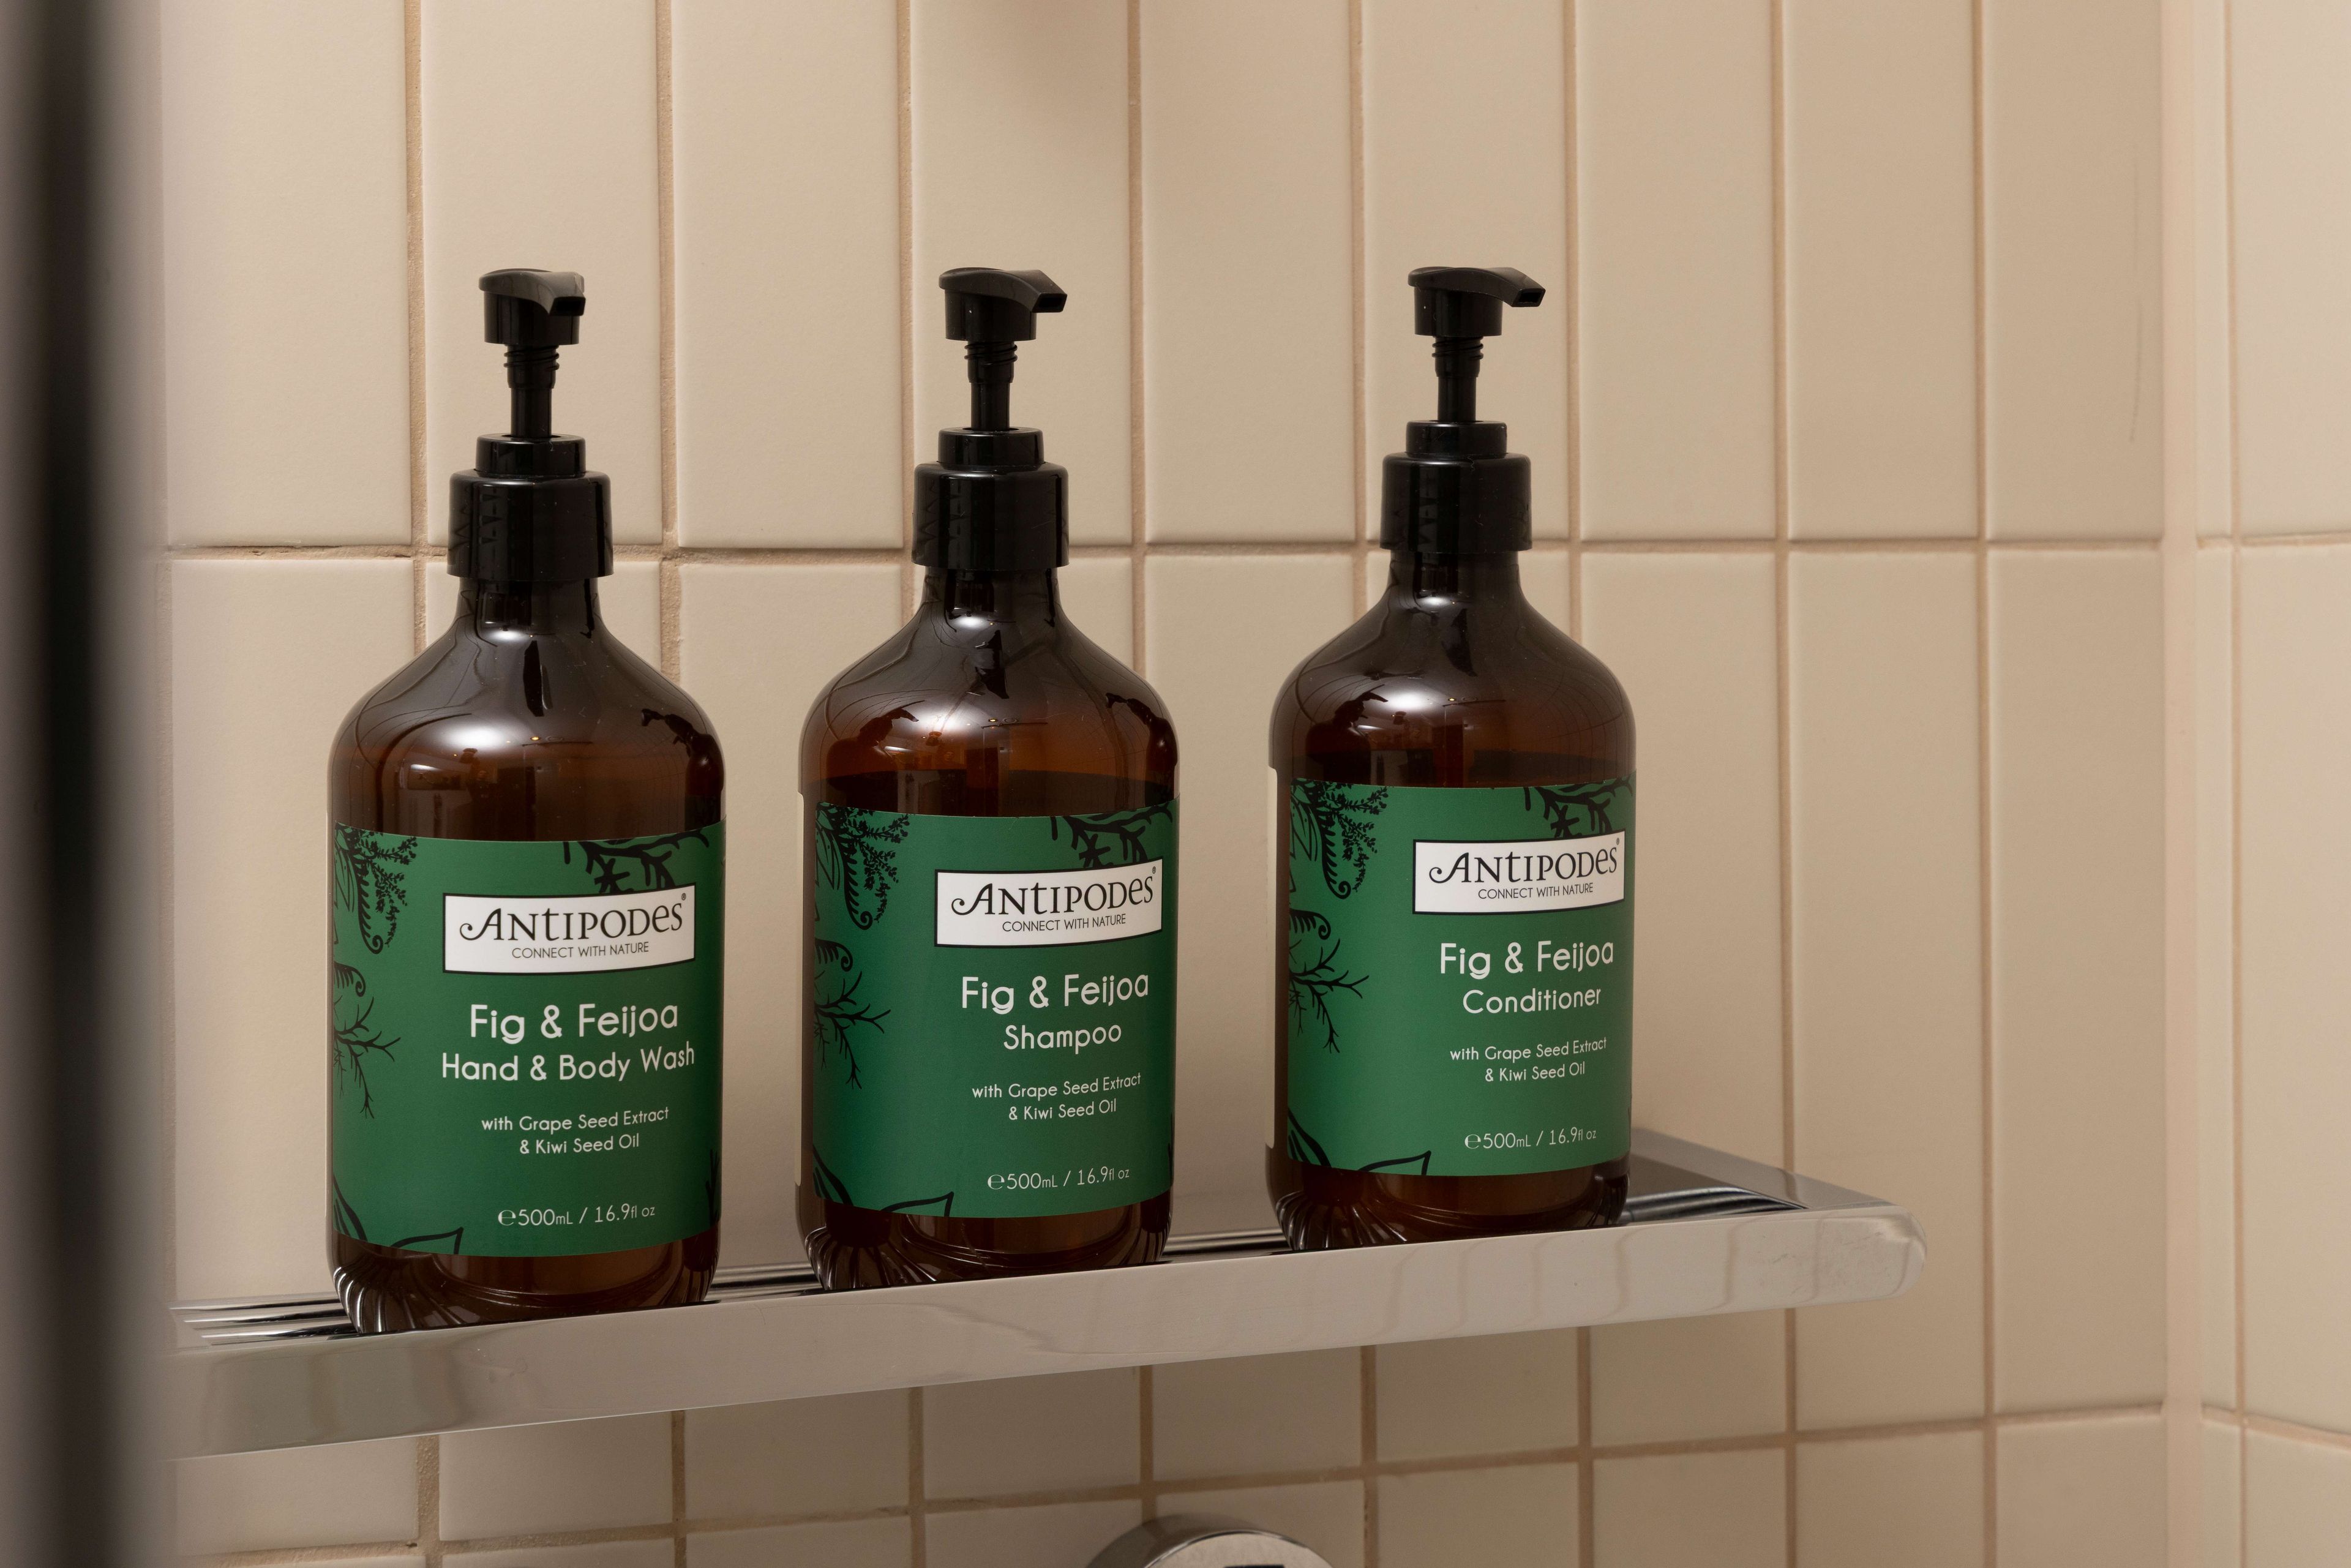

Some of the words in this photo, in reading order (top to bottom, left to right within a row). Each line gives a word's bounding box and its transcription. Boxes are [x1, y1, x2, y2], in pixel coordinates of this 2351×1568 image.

[1478, 887, 1534, 899] CONNECT
[1536, 886, 1560, 898] WITH
[1562, 882, 1594, 896] NATURE
[1002, 920, 1061, 932] CONNECT
[1063, 918, 1089, 930] WITH
[1092, 913, 1126, 928] NATURE
[512, 947, 574, 959] CONNECT
[578, 945, 606, 957] WITH
[610, 941, 649, 956] NATURE
[1441, 942, 1491, 980] Fig
[1504, 942, 1524, 974] &
[1537, 940, 1613, 972] Feijoa
[962, 976, 1014, 1015] Fig
[1029, 975, 1049, 1008] &
[1064, 973, 1149, 1007] Feijoa
[1463, 988, 1601, 1014] Conditioner
[471, 1003, 525, 1045] Fig
[541, 1004, 563, 1039] &
[579, 1003, 678, 1038] Feijoa
[1003, 1024, 1122, 1055] Shampoo
[1450, 1046, 1479, 1060] with
[1485, 1046, 1531, 1063] Grape
[1535, 1041, 1569, 1058] Seed
[1573, 1037, 1607, 1054] Extract
[442, 1052, 519, 1081] Hand
[530, 1054, 547, 1081] &
[560, 1051, 631, 1082] Body
[640, 1041, 694, 1073] Wash
[1485, 1068, 1494, 1082] &
[1499, 1067, 1526, 1081] Kiwi
[1531, 1063, 1565, 1080] Seed
[1569, 1060, 1585, 1076] Oil
[972, 1084, 1002, 1098] with
[1008, 1083, 1058, 1101] Grape
[1062, 1078, 1098, 1095] Seed
[1103, 1072, 1141, 1091] Extract
[481, 1116, 513, 1130] with
[519, 1116, 572, 1135] Grape
[578, 1111, 618, 1129] Seed
[623, 1106, 669, 1125] Extract
[1008, 1106, 1018, 1120] &
[1024, 1106, 1052, 1120] Kiwi
[1058, 1101, 1094, 1118] Seed
[1098, 1098, 1116, 1114] Oil
[519, 1139, 530, 1155] &
[536, 1139, 567, 1154] Kiwi
[573, 1135, 613, 1153] Seed
[618, 1133, 639, 1149] Oil
[1535, 1130, 1543, 1146] /
[1586, 1130, 1597, 1140] oz
[1063, 1170, 1071, 1187] /
[1117, 1169, 1130, 1179] oz
[579, 1207, 588, 1224] /
[641, 1207, 655, 1217] oz
